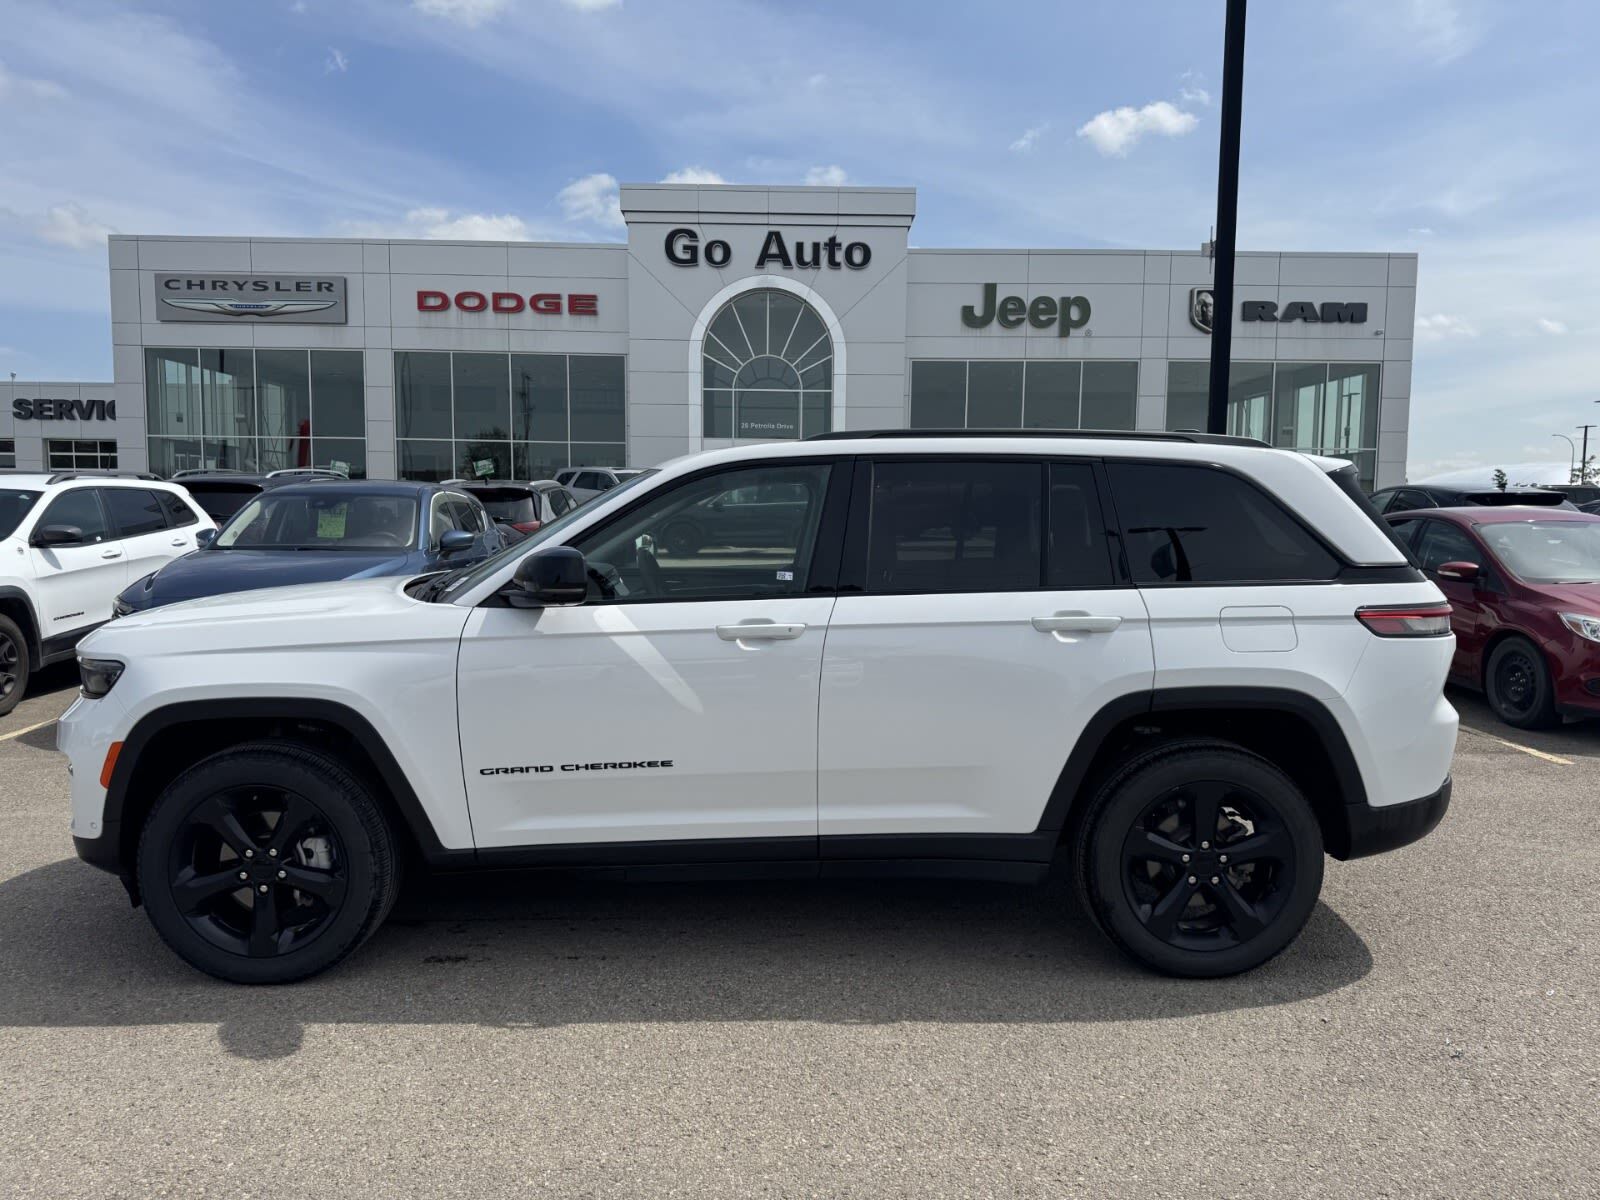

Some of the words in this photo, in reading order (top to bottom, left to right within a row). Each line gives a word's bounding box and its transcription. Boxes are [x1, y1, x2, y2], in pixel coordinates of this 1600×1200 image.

[664, 228, 731, 267] Go
[755, 230, 872, 269] Auto
[164, 279, 335, 292] CHRYSLER
[417, 291, 598, 316] DODGE
[962, 283, 1091, 337] Jeep
[1241, 301, 1368, 323] RAM
[479, 766, 554, 776] GRAND
[560, 760, 674, 771] CHEROKEE
